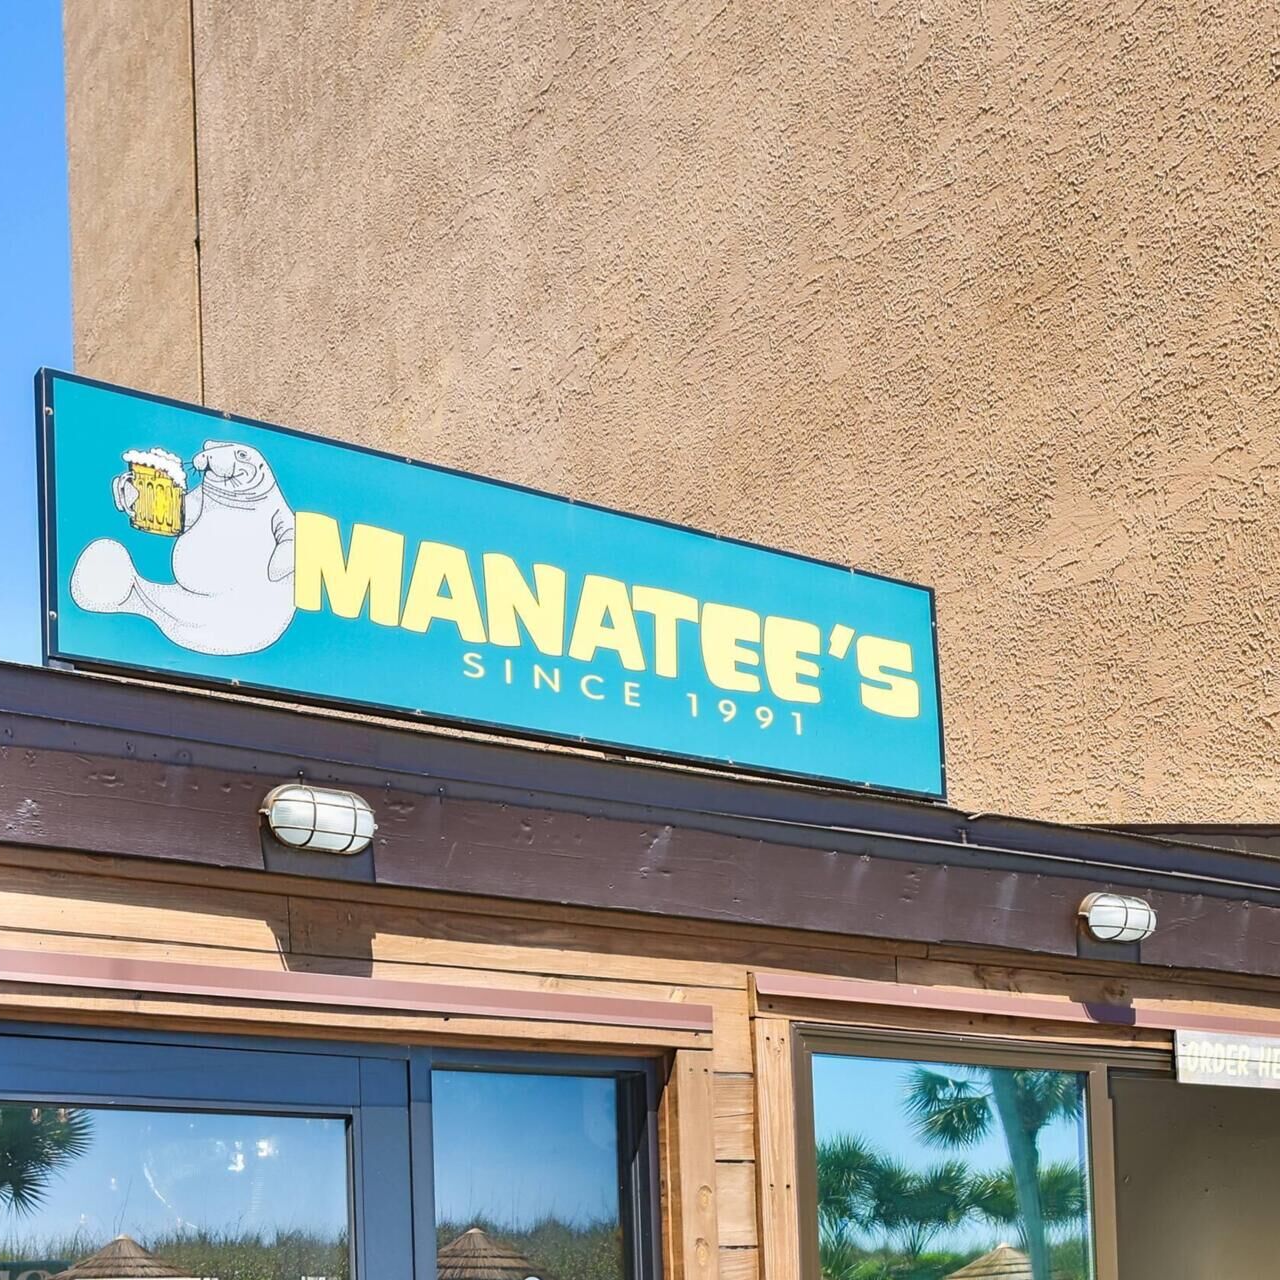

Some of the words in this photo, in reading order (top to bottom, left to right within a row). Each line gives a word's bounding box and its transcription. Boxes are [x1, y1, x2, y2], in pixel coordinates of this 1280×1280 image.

[294, 511, 920, 718] MANATEE'S
[463, 652, 641, 707] SINCE
[686, 692, 803, 736] 1991
[1185, 1041, 1249, 1077] ORDER
